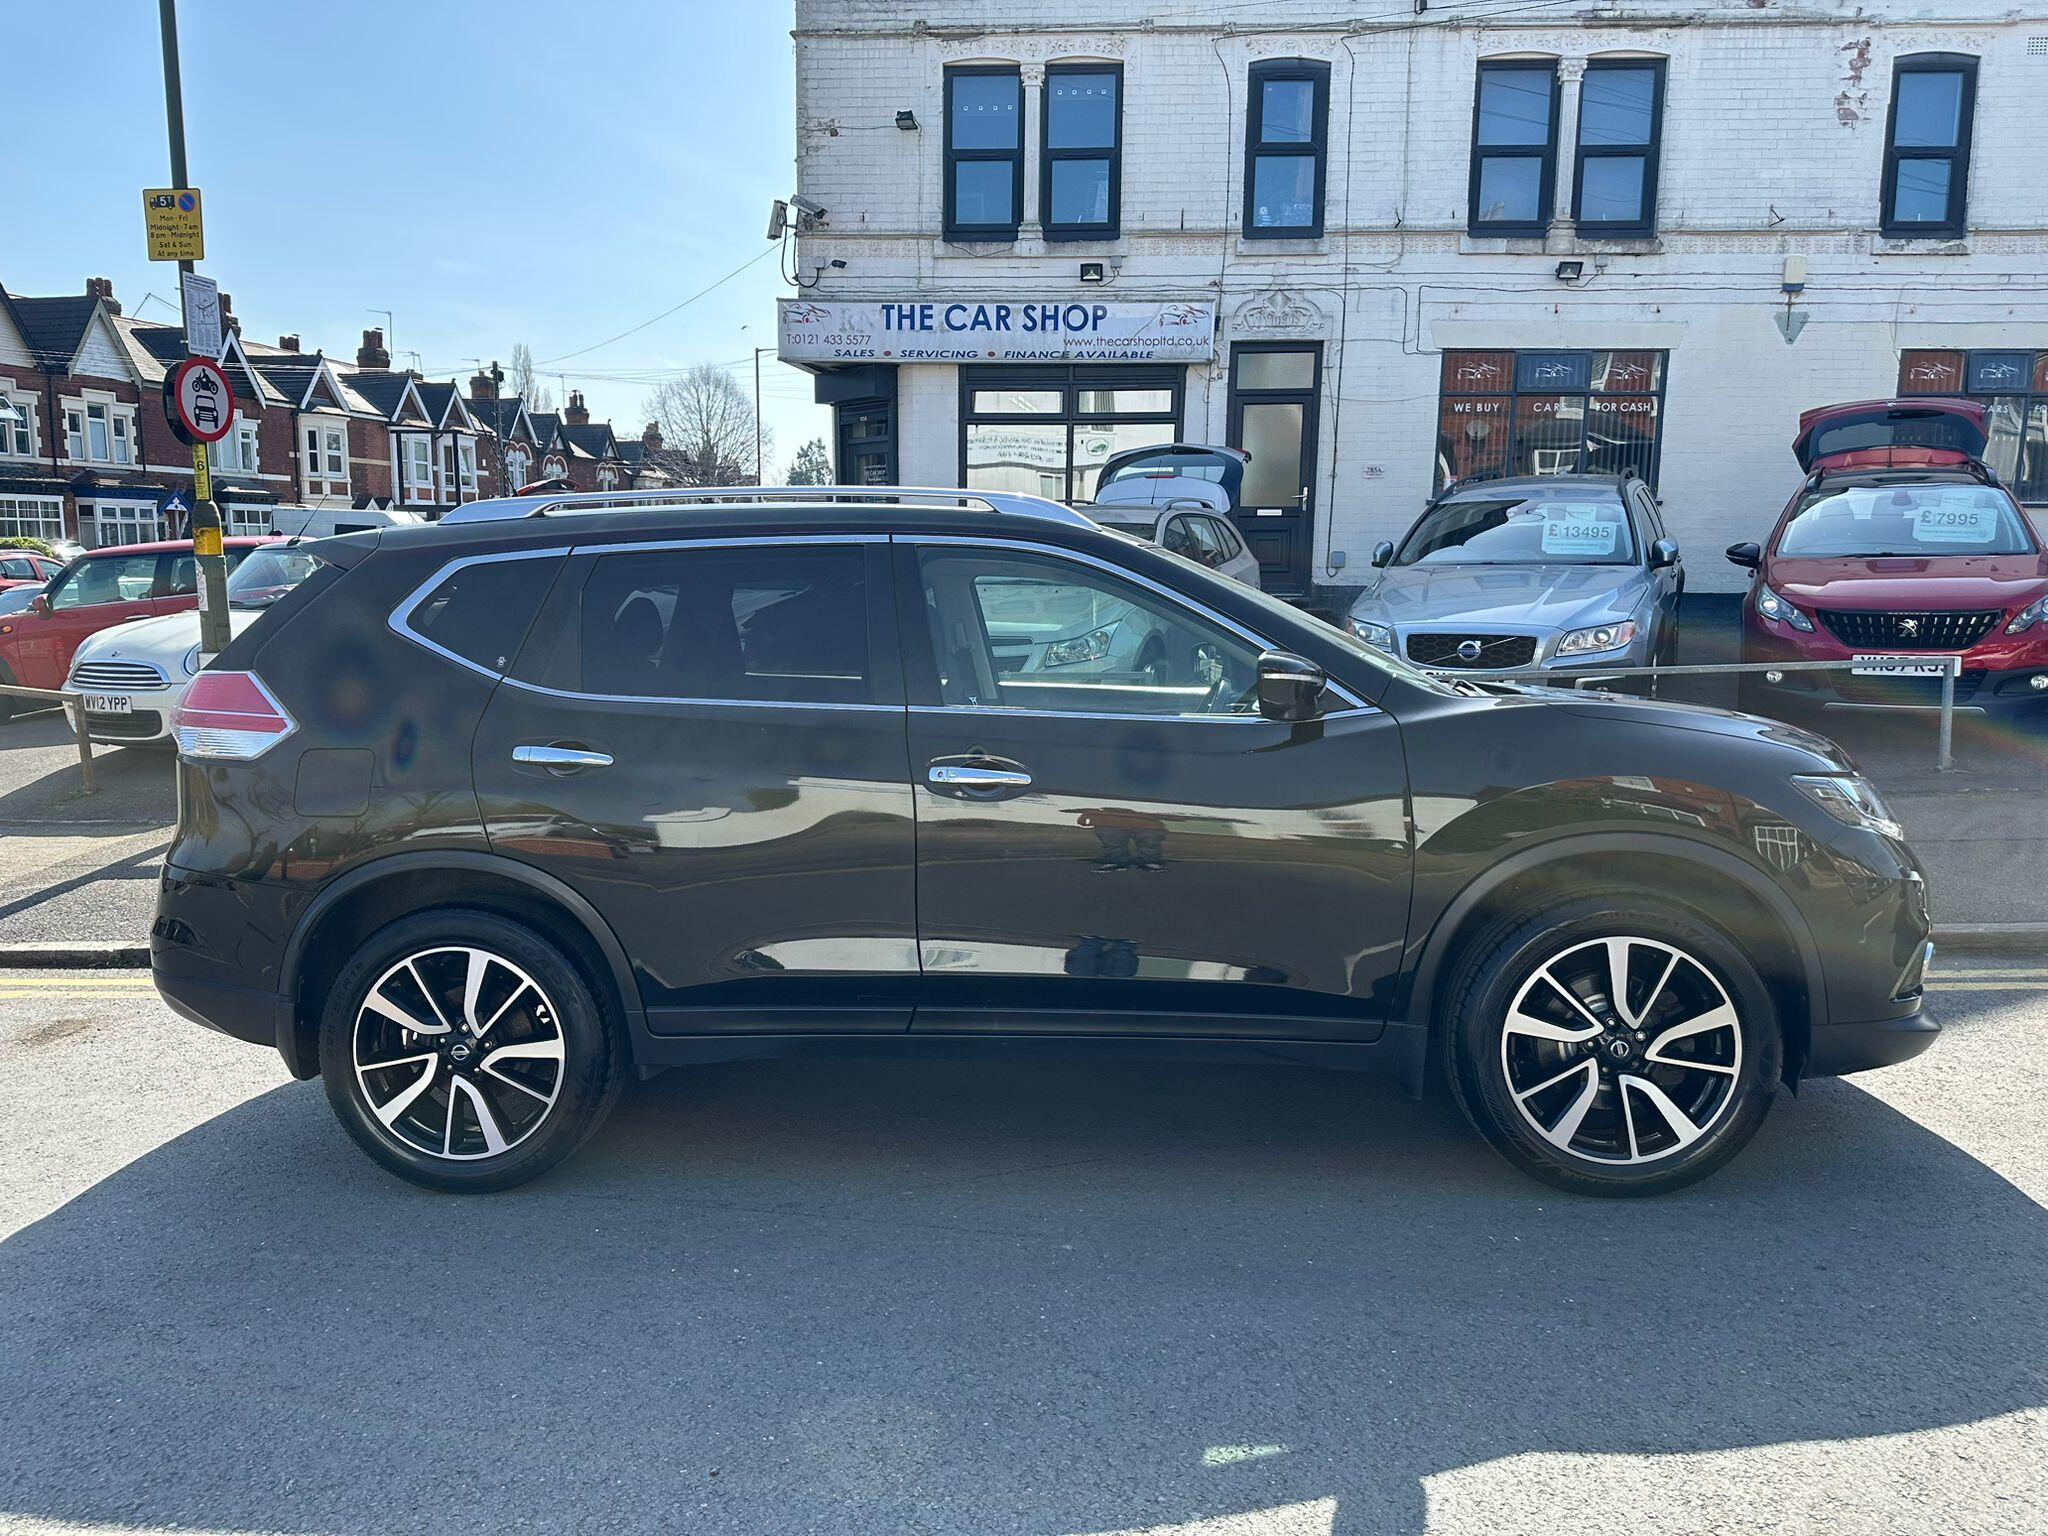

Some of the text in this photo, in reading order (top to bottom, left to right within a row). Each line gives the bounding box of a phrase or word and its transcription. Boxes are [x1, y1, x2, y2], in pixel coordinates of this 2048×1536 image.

[881, 304, 933, 331] THE
[944, 304, 1011, 331] CAR
[1021, 304, 1107, 331] SHOP
[786, 334, 871, 345] T:0121 433 5577
[1063, 335, 1209, 348] www.thecarshopltd.co.uk
[900, 350, 978, 358] SERVICING
[1004, 350, 1070, 358] FINANCE
[1074, 350, 1154, 359] AVAILABLE
[1454, 402, 1651, 412] WE BUY CARS FOR CASH
[1980, 404, 2008, 413] CARS
[197, 460, 205, 471] 6
[1921, 510, 1979, 525] £ 7995
[1548, 524, 1609, 538] £ 13495
[85, 696, 127, 710] WV12 YPP
